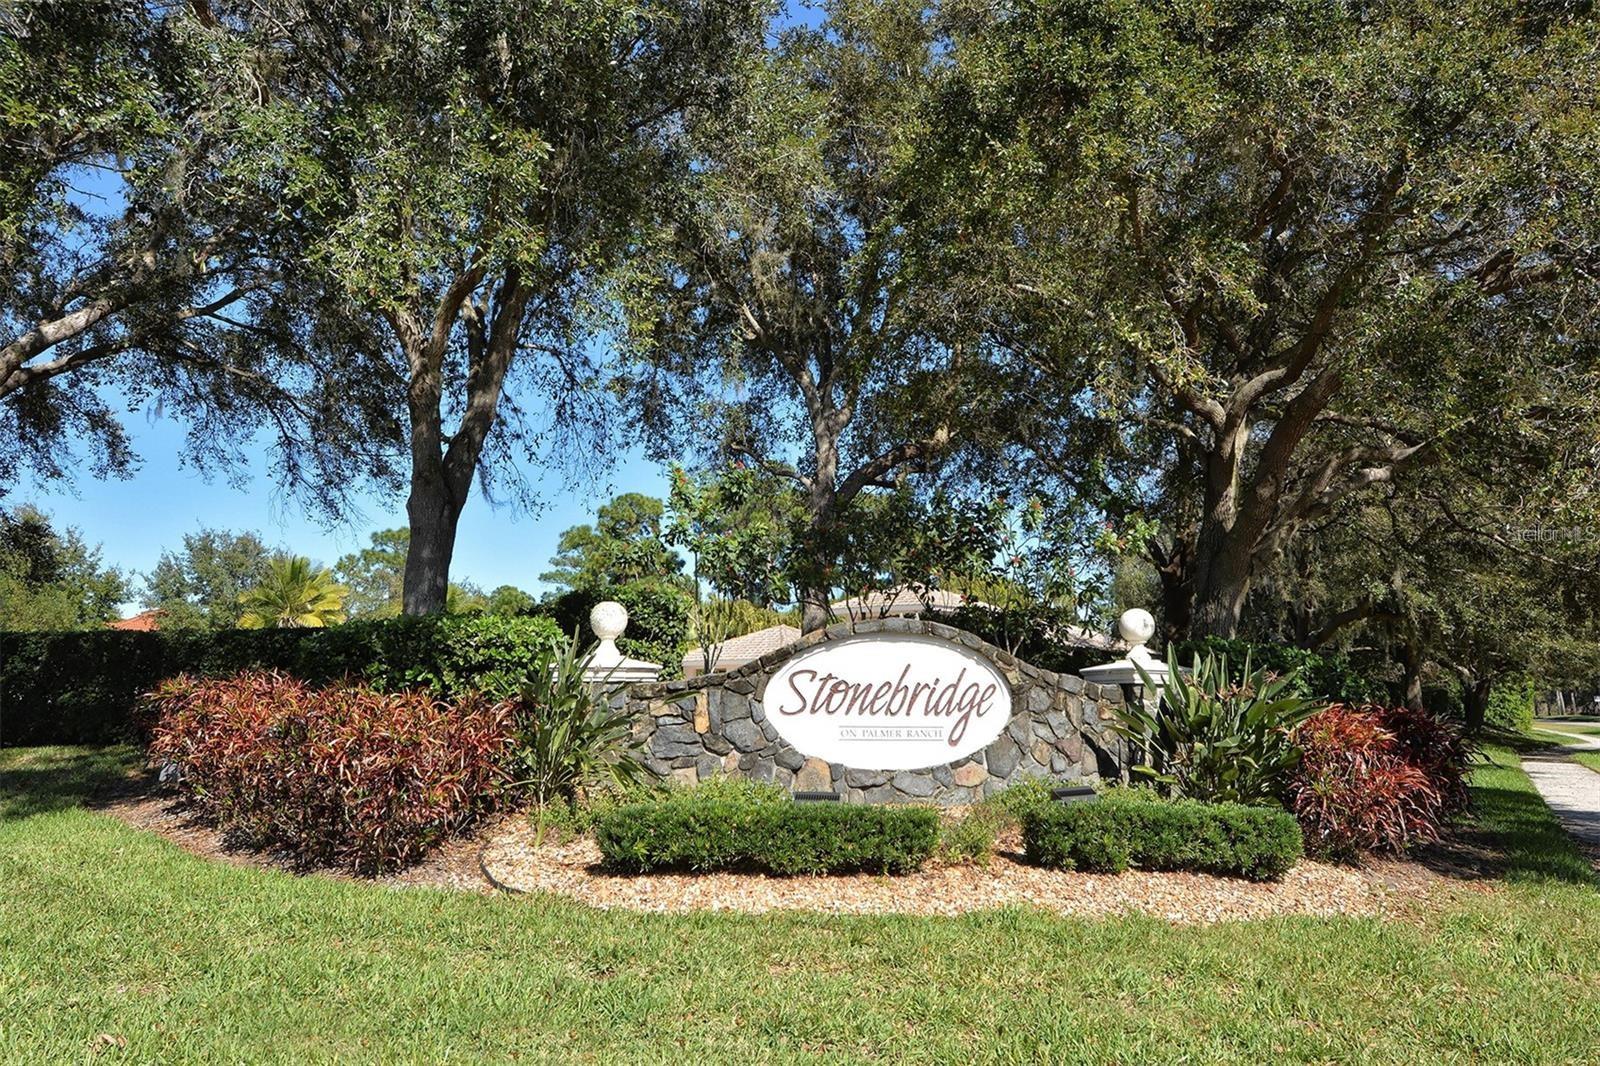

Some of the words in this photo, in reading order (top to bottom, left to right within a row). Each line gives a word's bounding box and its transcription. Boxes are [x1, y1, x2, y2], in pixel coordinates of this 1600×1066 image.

[779, 663, 997, 747] Stonebridge
[840, 729, 857, 738] ON
[862, 729, 902, 738] PALMER
[906, 729, 943, 738] RANCH
